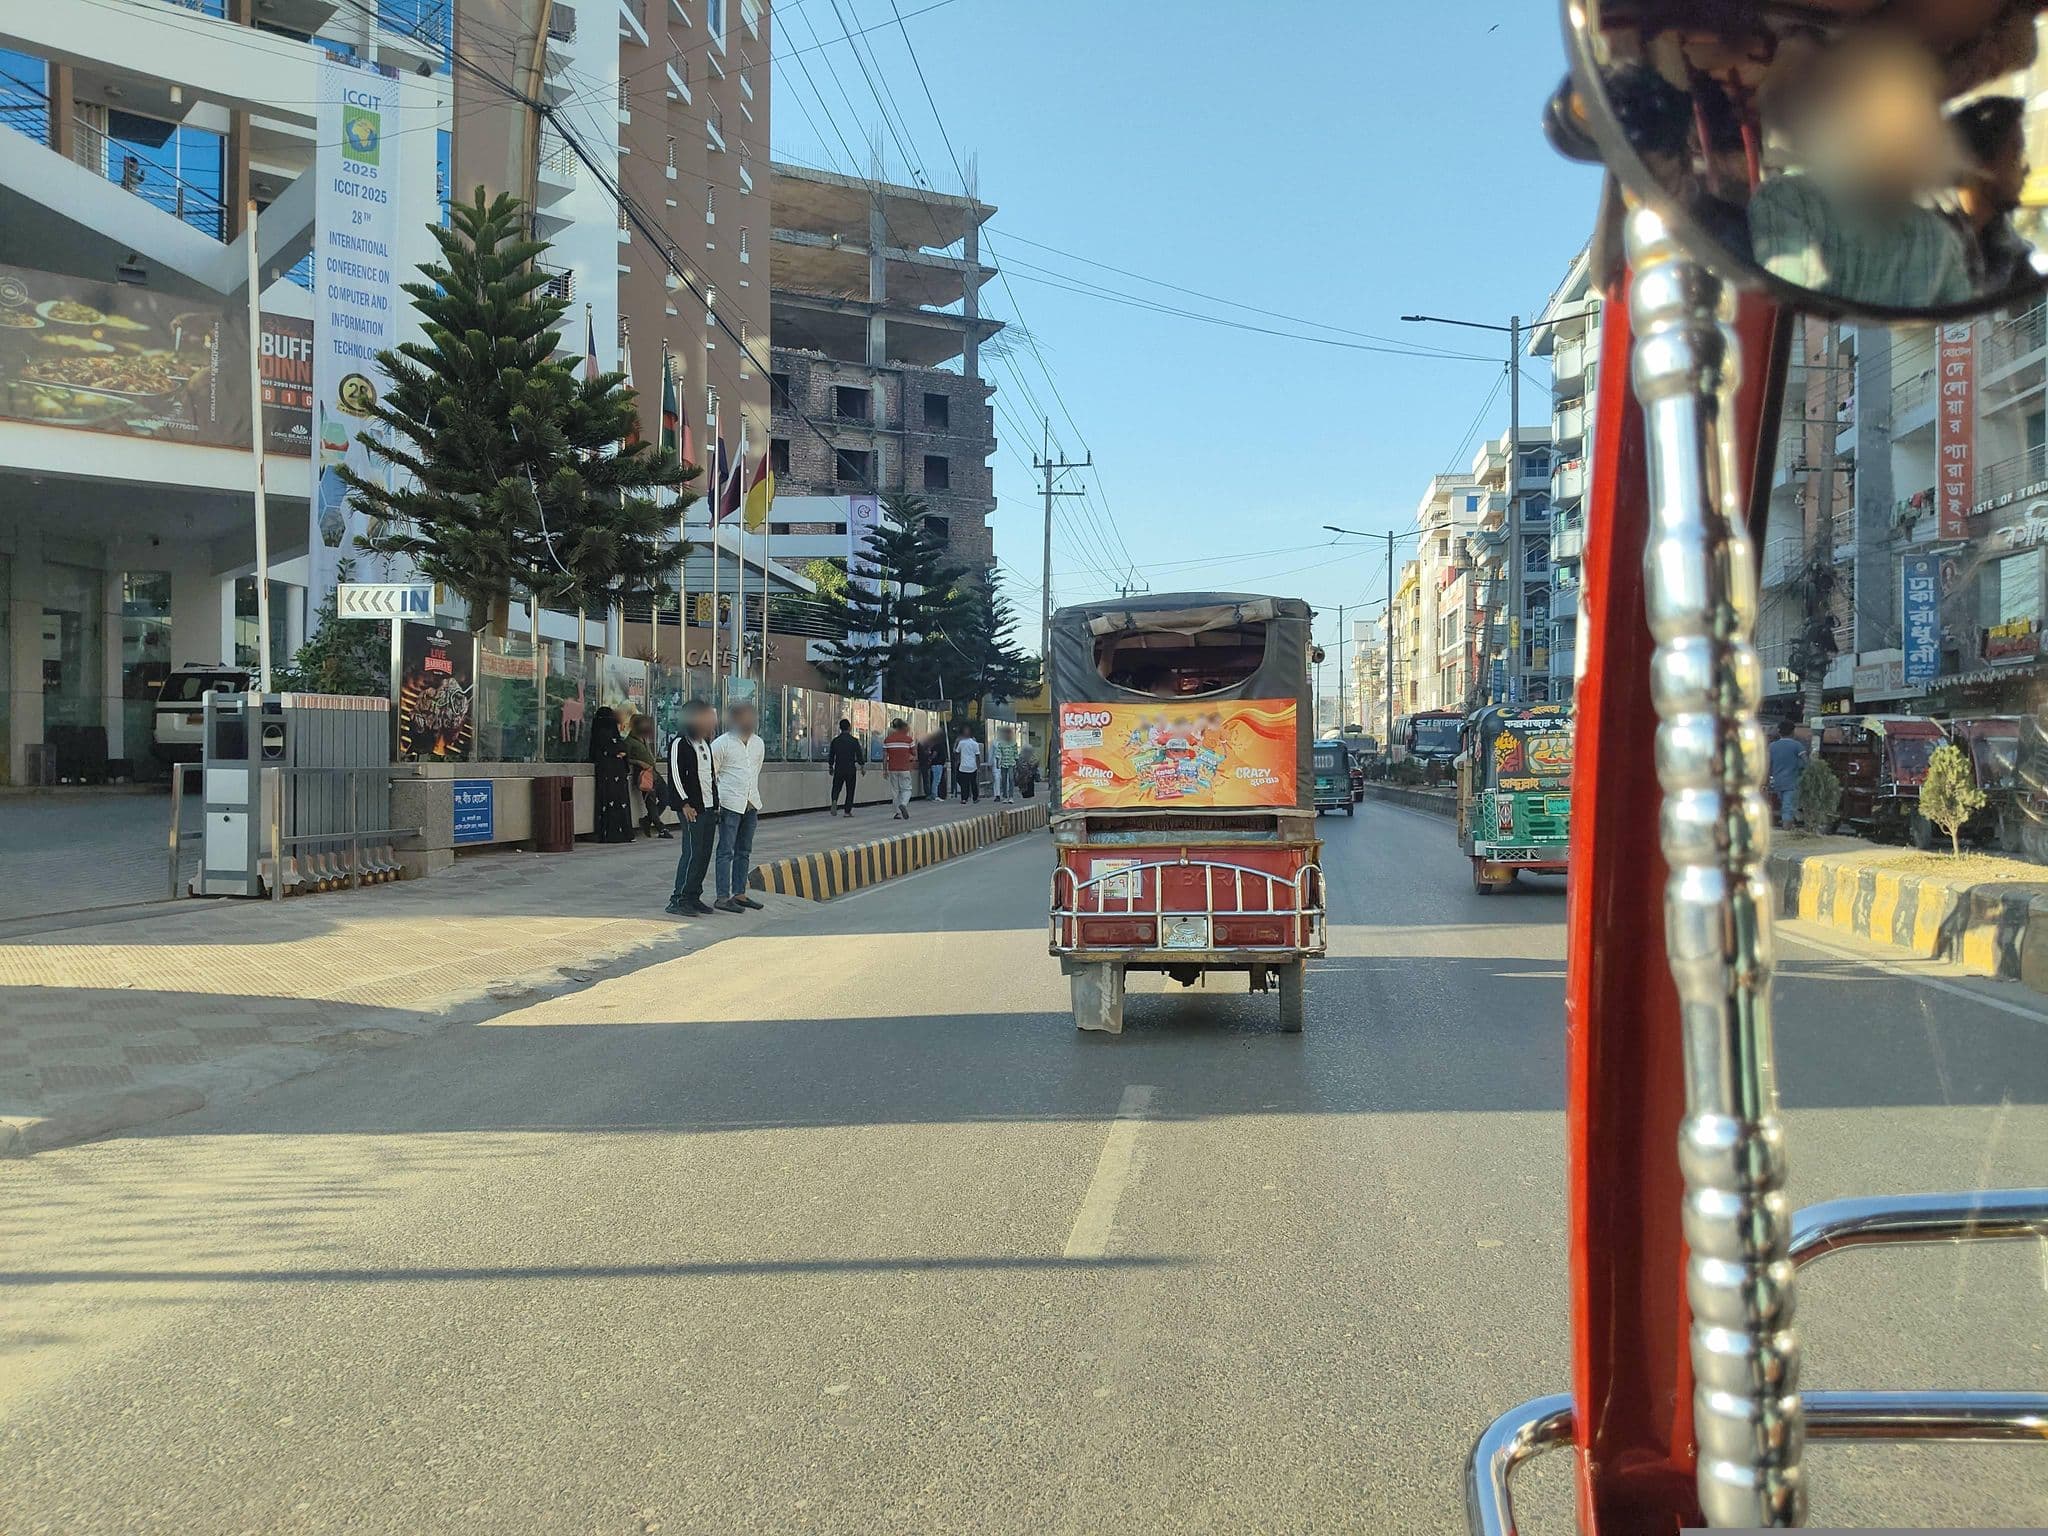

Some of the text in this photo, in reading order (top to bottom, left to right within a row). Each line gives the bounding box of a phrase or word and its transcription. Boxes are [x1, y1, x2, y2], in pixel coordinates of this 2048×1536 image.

[343, 88, 381, 110] ICCIT
[342, 161, 378, 179] 2025
[334, 178, 387, 204] ICCIT 2025
[329, 231, 388, 258] INTERNATIONAL
[327, 257, 390, 285] CONFERENCE ON
[328, 284, 388, 310] COMPUTER AND
[332, 311, 384, 336] INFORMATION
[1944, 362, 1969, 434] দেলোয়ার
[1944, 444, 1969, 535] প্যারাডাইস
[2000, 492, 2013, 505] OF
[401, 590, 429, 612] IN
[431, 648, 446, 660] LIVE
[1064, 711, 1111, 728] KRAKO
[1078, 766, 1114, 778] KRAKO
[1236, 767, 1271, 779] CRAZY
